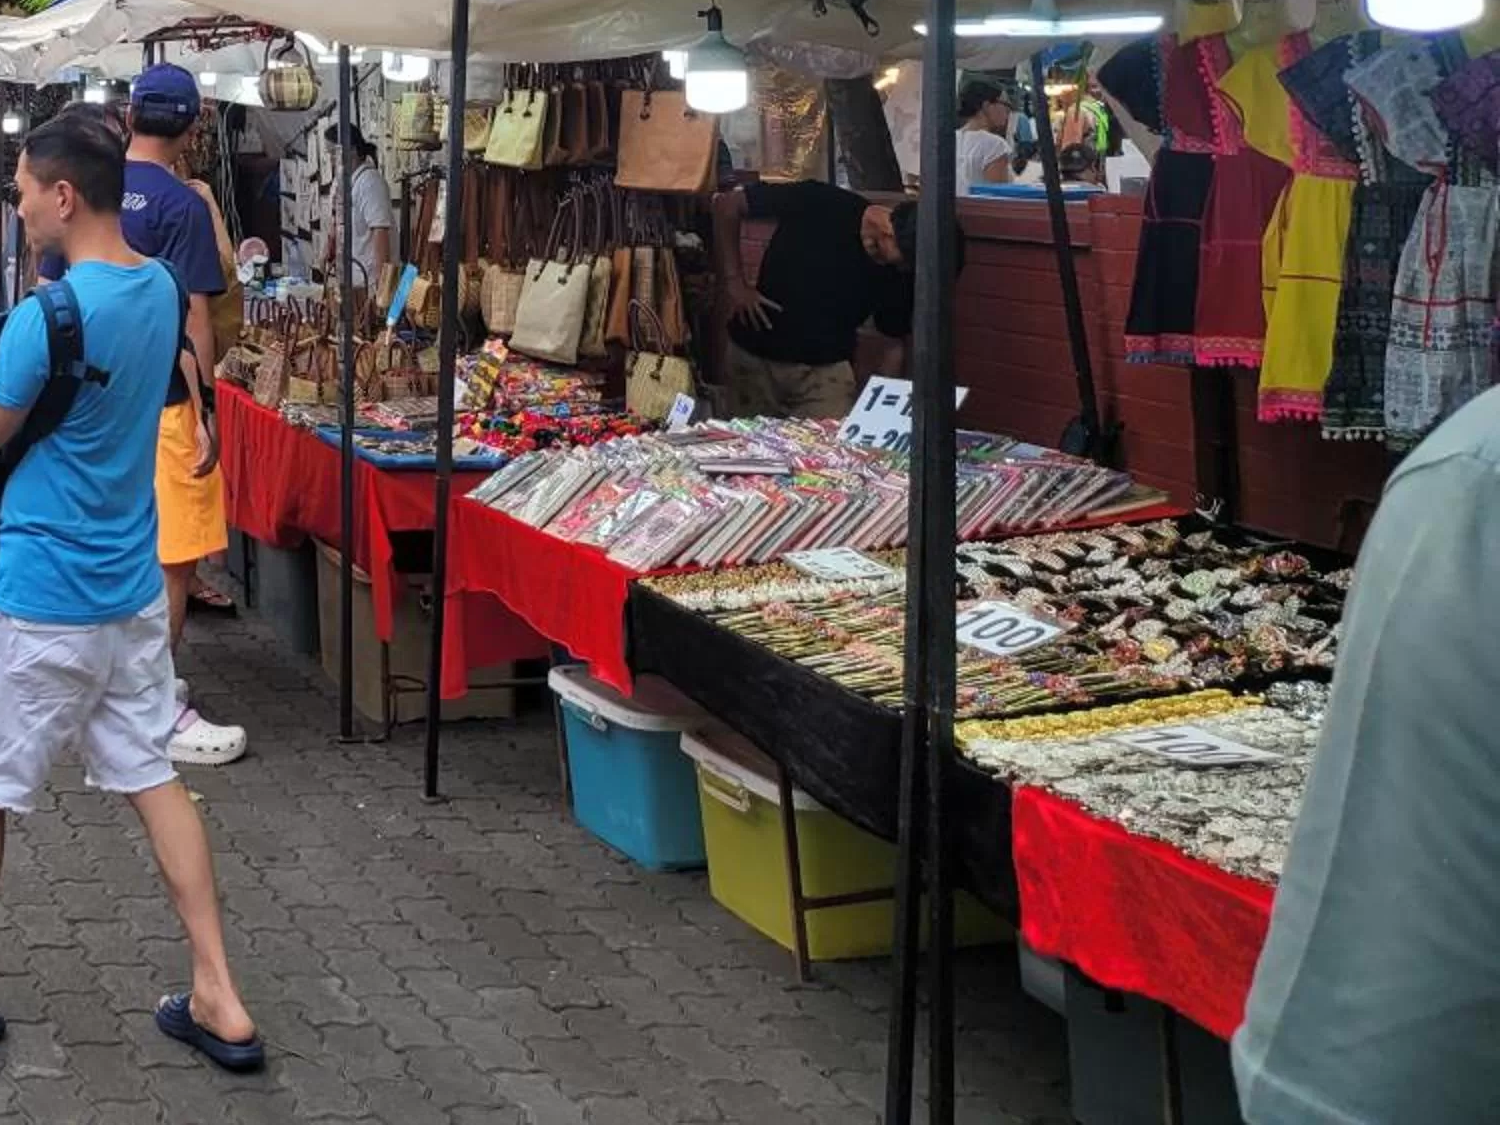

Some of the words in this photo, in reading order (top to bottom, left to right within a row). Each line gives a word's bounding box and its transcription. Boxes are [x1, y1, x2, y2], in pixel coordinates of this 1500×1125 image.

[845, 423, 912, 452] 2=20
[956, 608, 1046, 648] 100
[1132, 731, 1253, 760] 100
